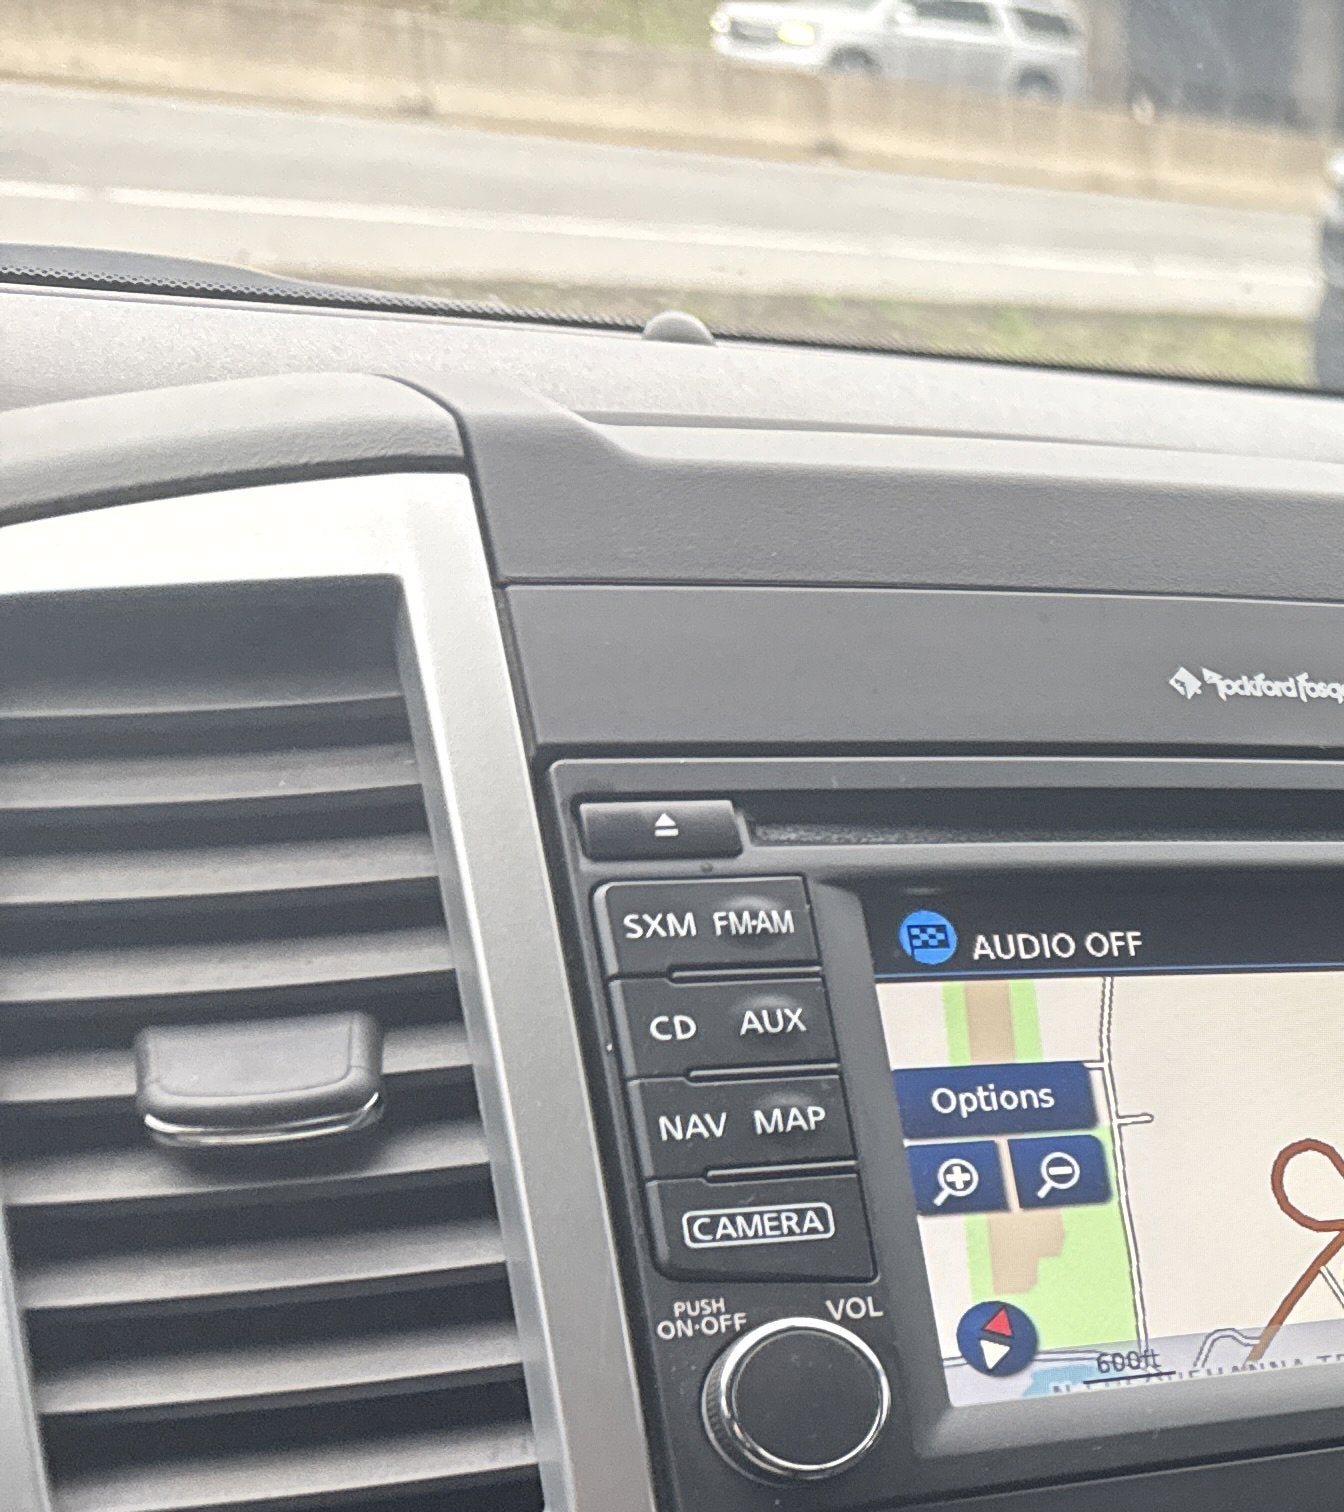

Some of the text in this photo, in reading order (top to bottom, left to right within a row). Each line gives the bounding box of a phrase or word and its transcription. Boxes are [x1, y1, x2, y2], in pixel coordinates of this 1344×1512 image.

[623, 911, 698, 939] SXM
[973, 931, 1143, 960] AUDIO OFF
[649, 1007, 808, 1041] CD AUX
[930, 1083, 1056, 1118] Options
[658, 1105, 826, 1141] NAV MAP
[692, 1209, 825, 1241] CAMERA
[673, 1297, 726, 1318] PUSH
[825, 1296, 884, 1321] VOL
[1096, 1348, 1162, 1374] 600ft
